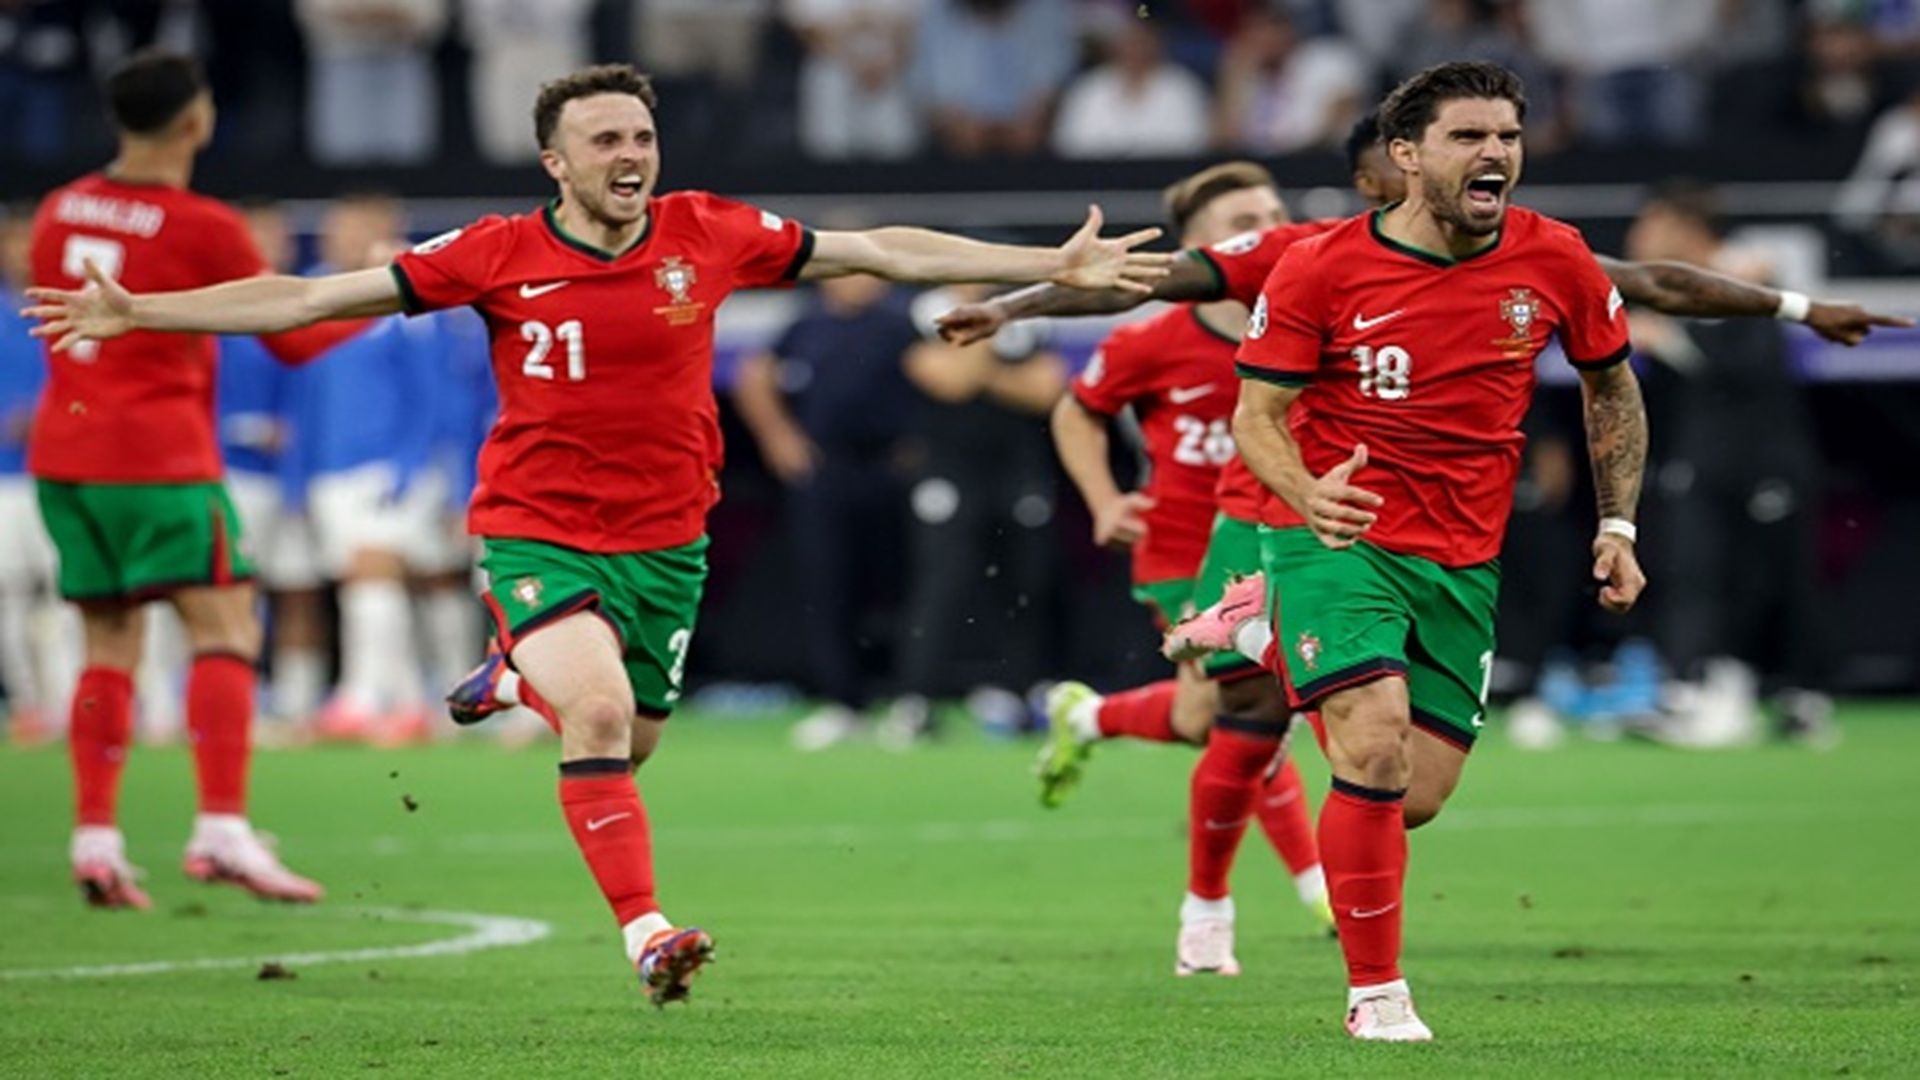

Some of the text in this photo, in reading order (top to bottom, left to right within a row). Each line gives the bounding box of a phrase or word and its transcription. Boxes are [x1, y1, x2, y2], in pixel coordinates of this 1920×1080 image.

[520, 320, 586, 381] 21
[1352, 345, 1412, 400] 18
[1173, 415, 1237, 466] 26
